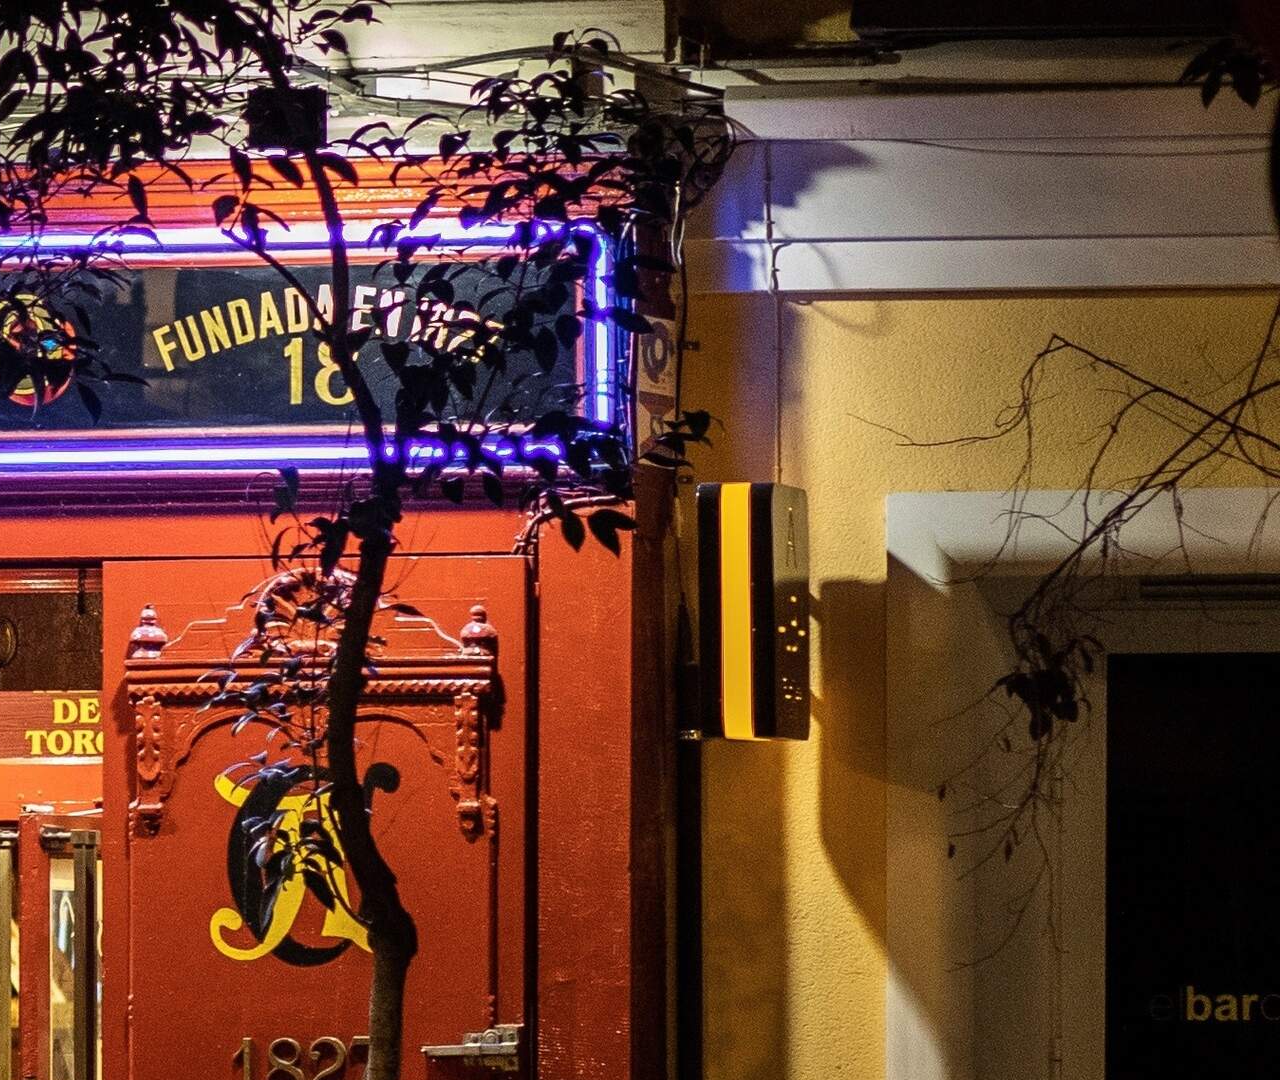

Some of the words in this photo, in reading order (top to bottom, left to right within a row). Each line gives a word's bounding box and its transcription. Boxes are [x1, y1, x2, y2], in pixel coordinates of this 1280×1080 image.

[153, 283, 335, 372] FUNDADA
[53, 698, 101, 724] DE
[25, 730, 104, 756] TOR
